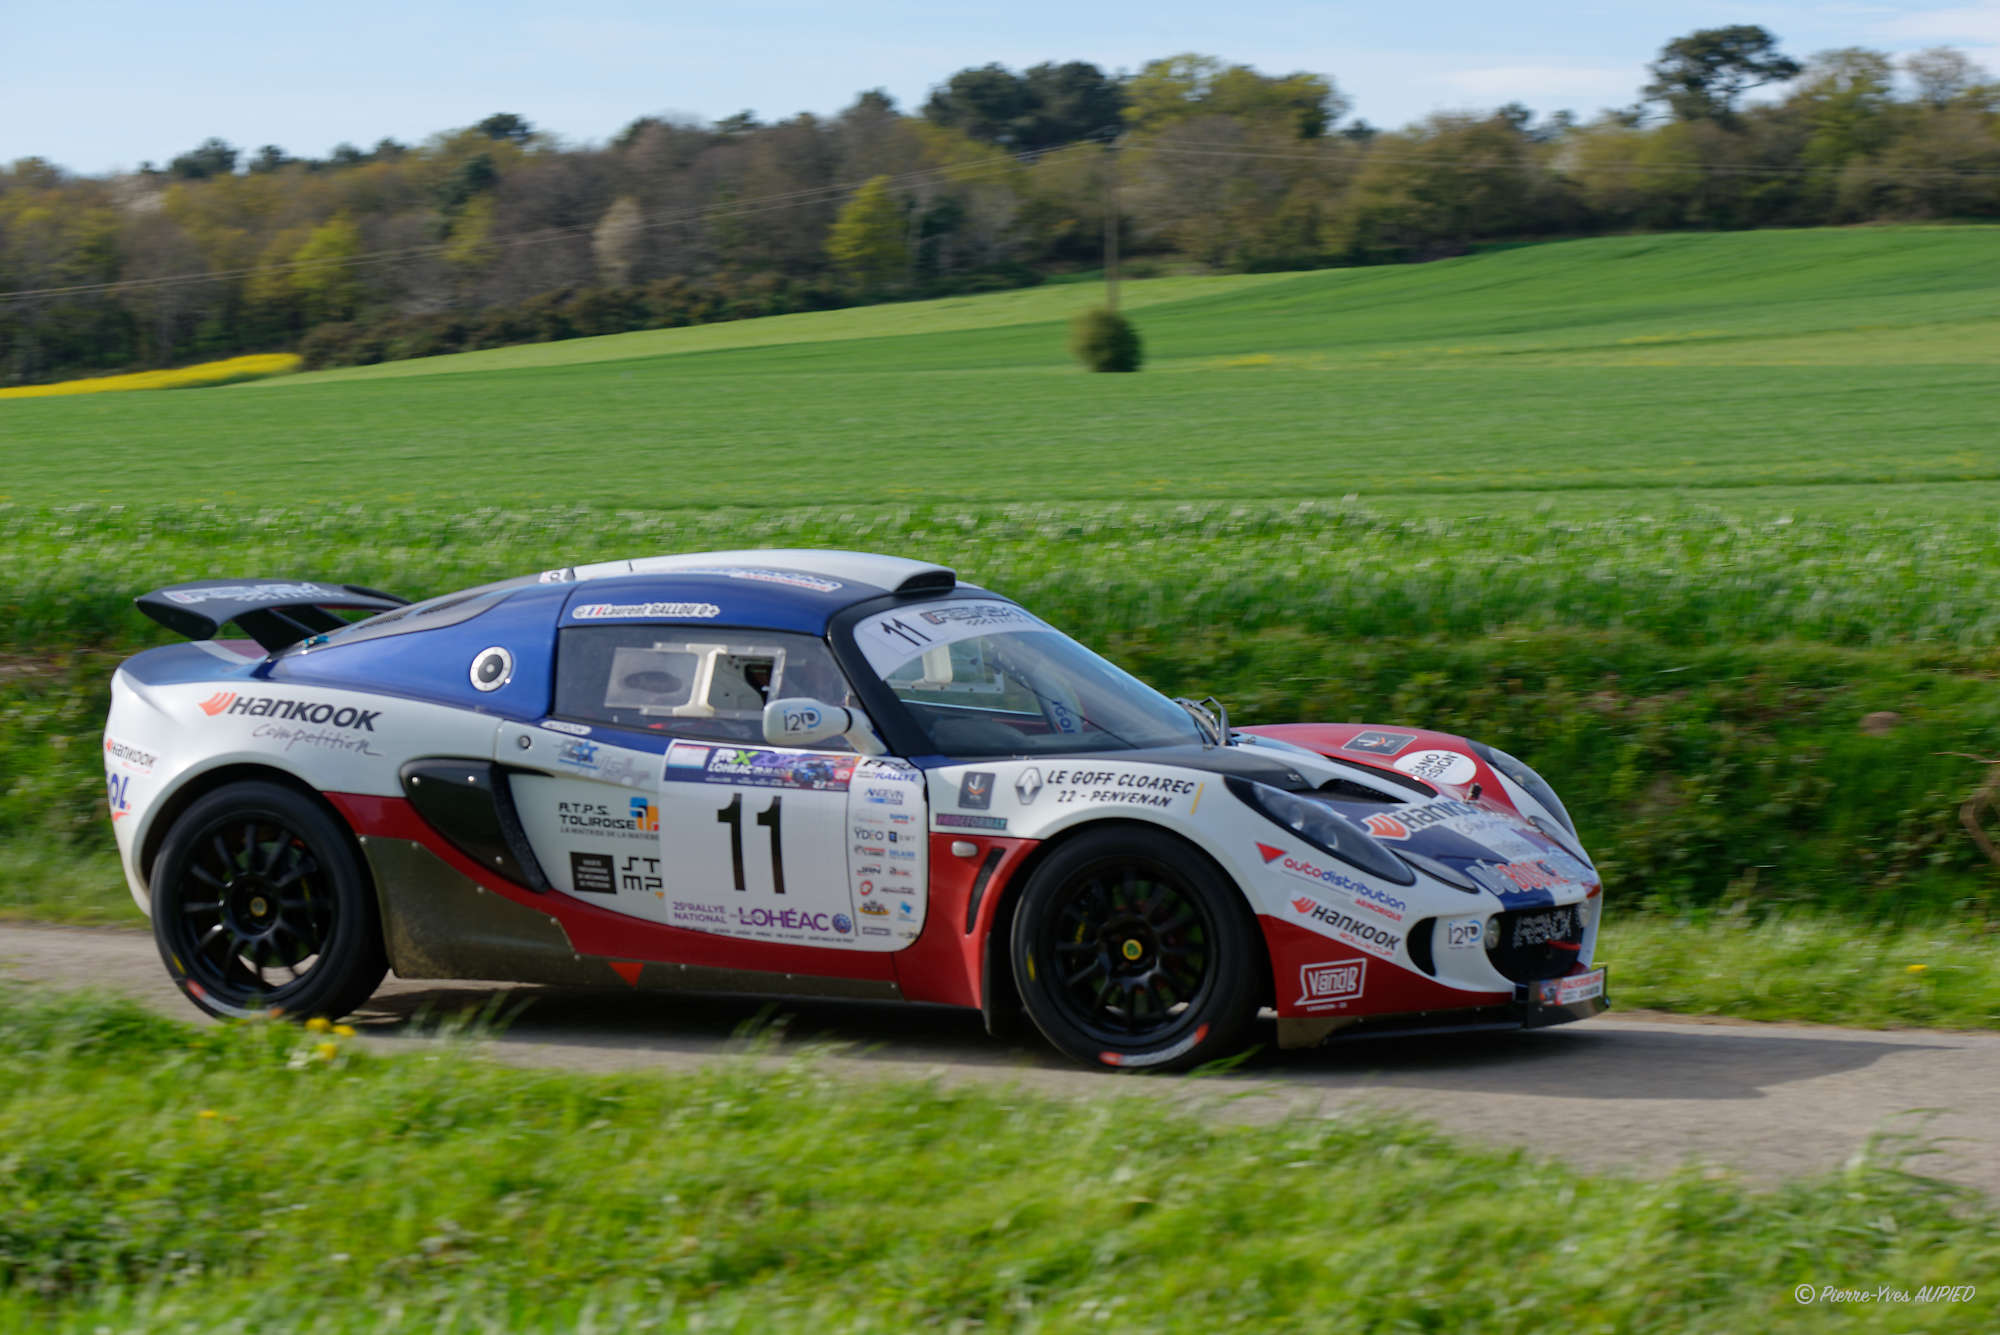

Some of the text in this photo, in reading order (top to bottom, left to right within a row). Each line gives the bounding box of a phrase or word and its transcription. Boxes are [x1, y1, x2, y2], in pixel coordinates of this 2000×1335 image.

[881, 619, 932, 647] 11
[1046, 770, 1195, 795] LE GOFF CLOAREC
[1057, 790, 1076, 803] 22
[1089, 791, 1173, 808] PENVENAN
[717, 792, 786, 894] 11
[1283, 858, 1407, 912] autodistribution
[674, 911, 728, 924] NATIONAL
[738, 906, 830, 932] LOHÉAC
